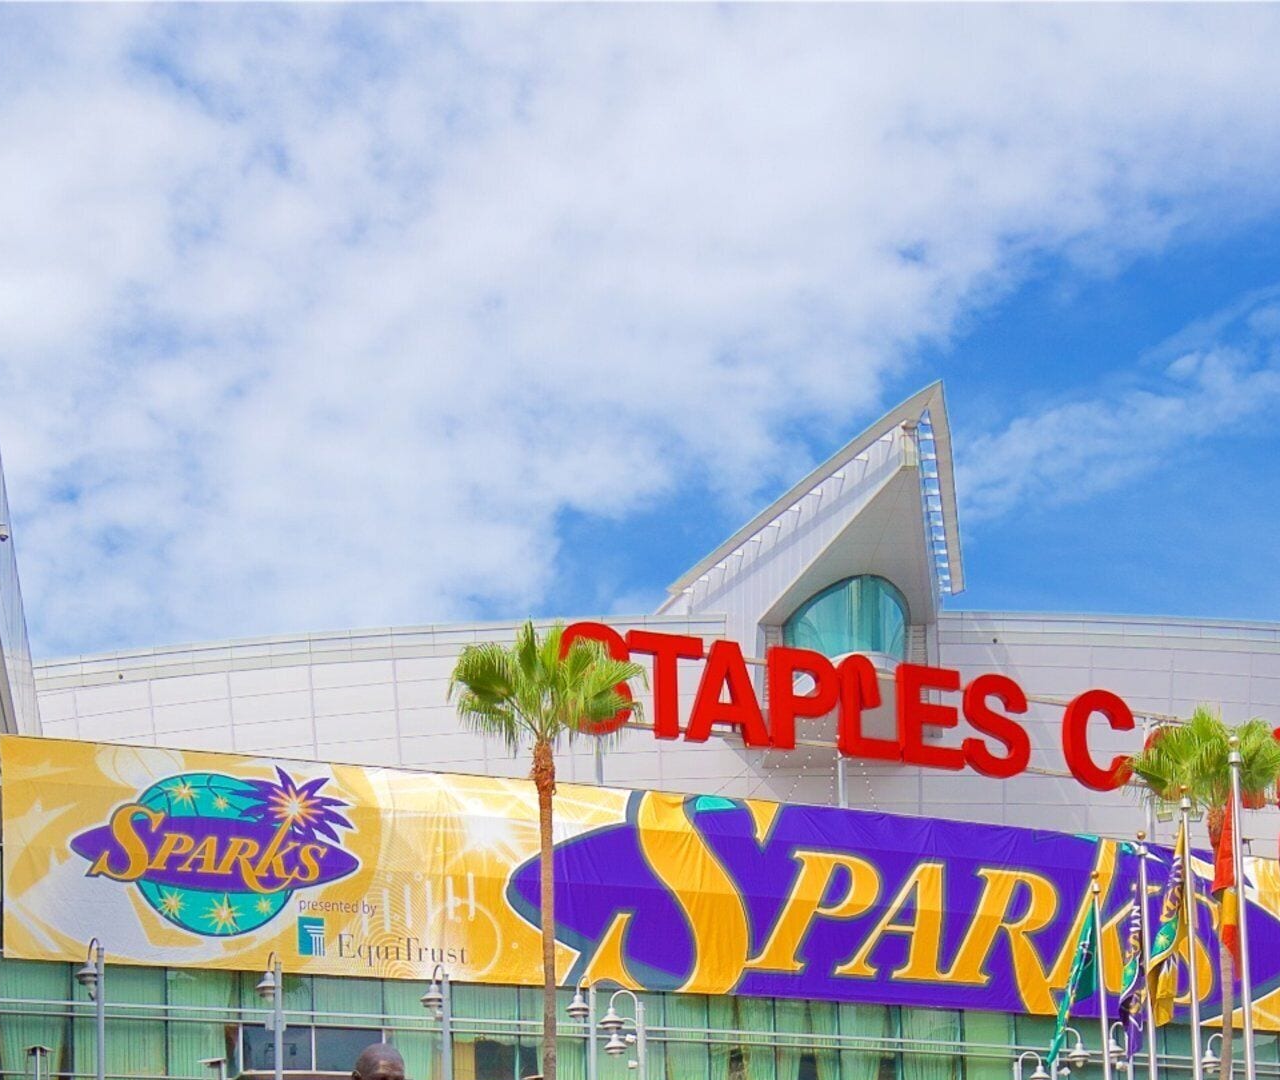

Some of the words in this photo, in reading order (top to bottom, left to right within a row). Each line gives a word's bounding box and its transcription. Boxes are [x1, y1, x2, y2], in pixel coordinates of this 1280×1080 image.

[298, 900, 359, 914] presented
[362, 901, 377, 917] by
[338, 933, 467, 967] EquiTrust
